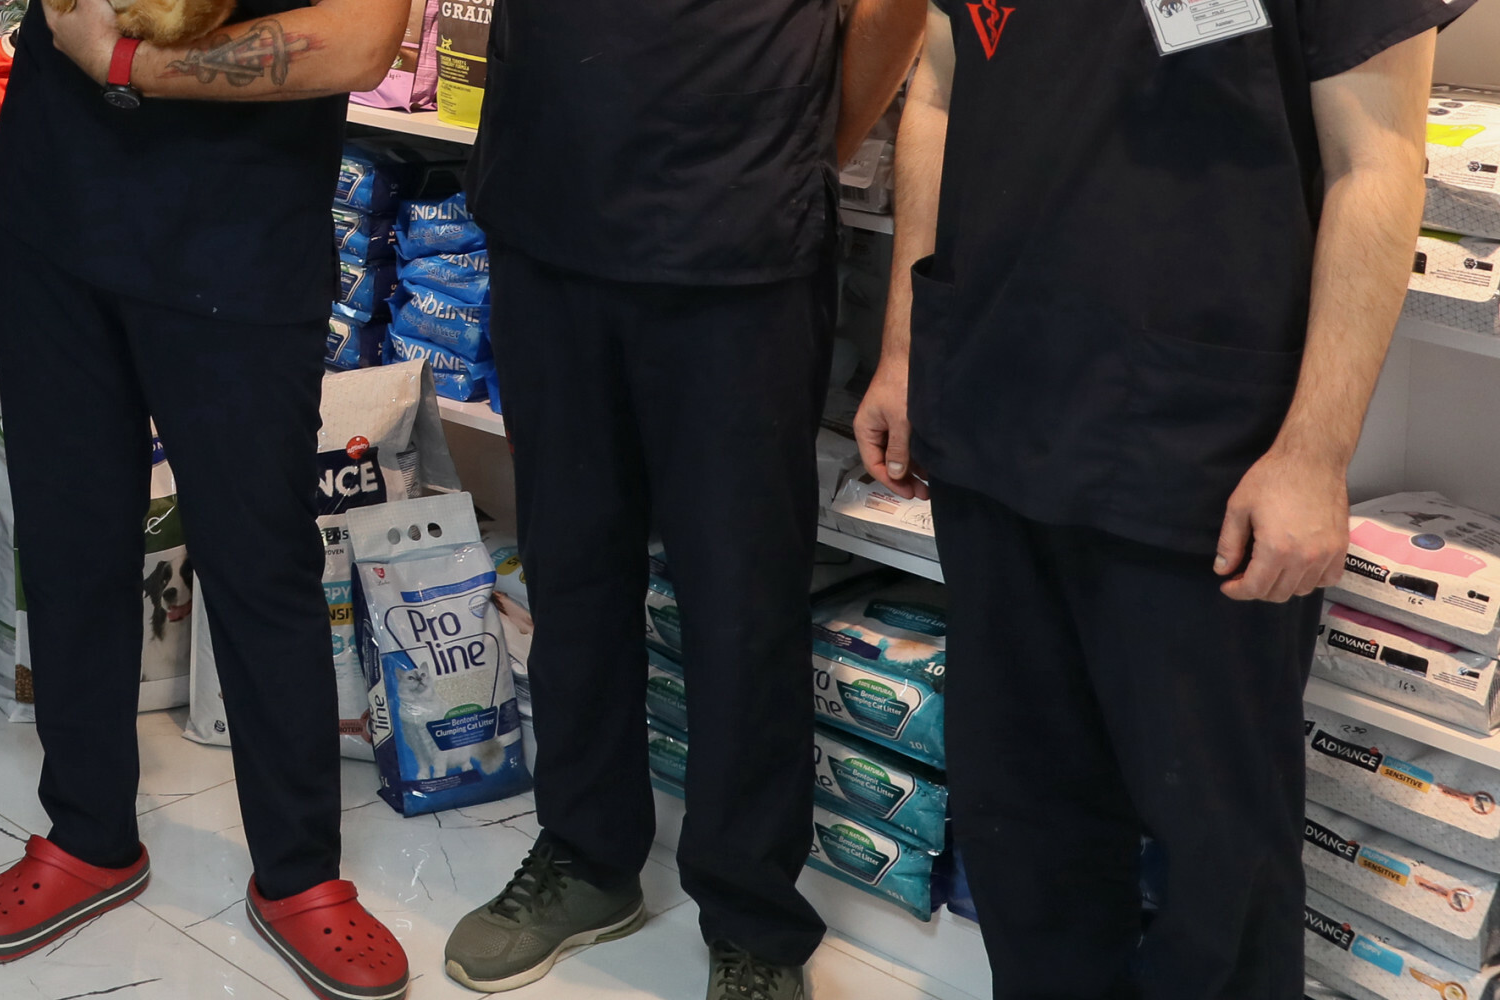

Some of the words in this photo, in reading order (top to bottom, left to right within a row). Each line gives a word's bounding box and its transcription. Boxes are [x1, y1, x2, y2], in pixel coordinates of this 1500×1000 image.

[442, 1, 492, 24] GRAIN
[319, 461, 378, 497] NCE
[325, 548, 345, 556] OVEN
[407, 609, 461, 642] Pro
[1331, 632, 1377, 653] ADVANCE
[425, 641, 486, 676] line
[924, 661, 946, 676] 10
[860, 690, 887, 704] Bentonit
[871, 683, 893, 697] NATURAL
[375, 694, 389, 731] line
[872, 701, 883, 709] Cat
[883, 703, 902, 716] Litter
[435, 725, 467, 737] Clumping
[478, 718, 494, 727] Litter
[451, 715, 479, 727] Bentonit
[1315, 737, 1378, 768] ADVANCE
[852, 769, 878, 785] Bentonit
[863, 764, 886, 777] NATURAL
[1385, 768, 1423, 789] SENSITIVE
[865, 781, 876, 791] Cat
[877, 784, 894, 798] Litter
[838, 836, 864, 852] Bentonit
[849, 832, 870, 845] NATURAL
[1304, 825, 1355, 857] DVANCE
[1363, 849, 1390, 865] PUPPY
[851, 849, 861, 859] Cat
[862, 851, 879, 866] Litter
[1363, 860, 1401, 882] SENSITIVE
